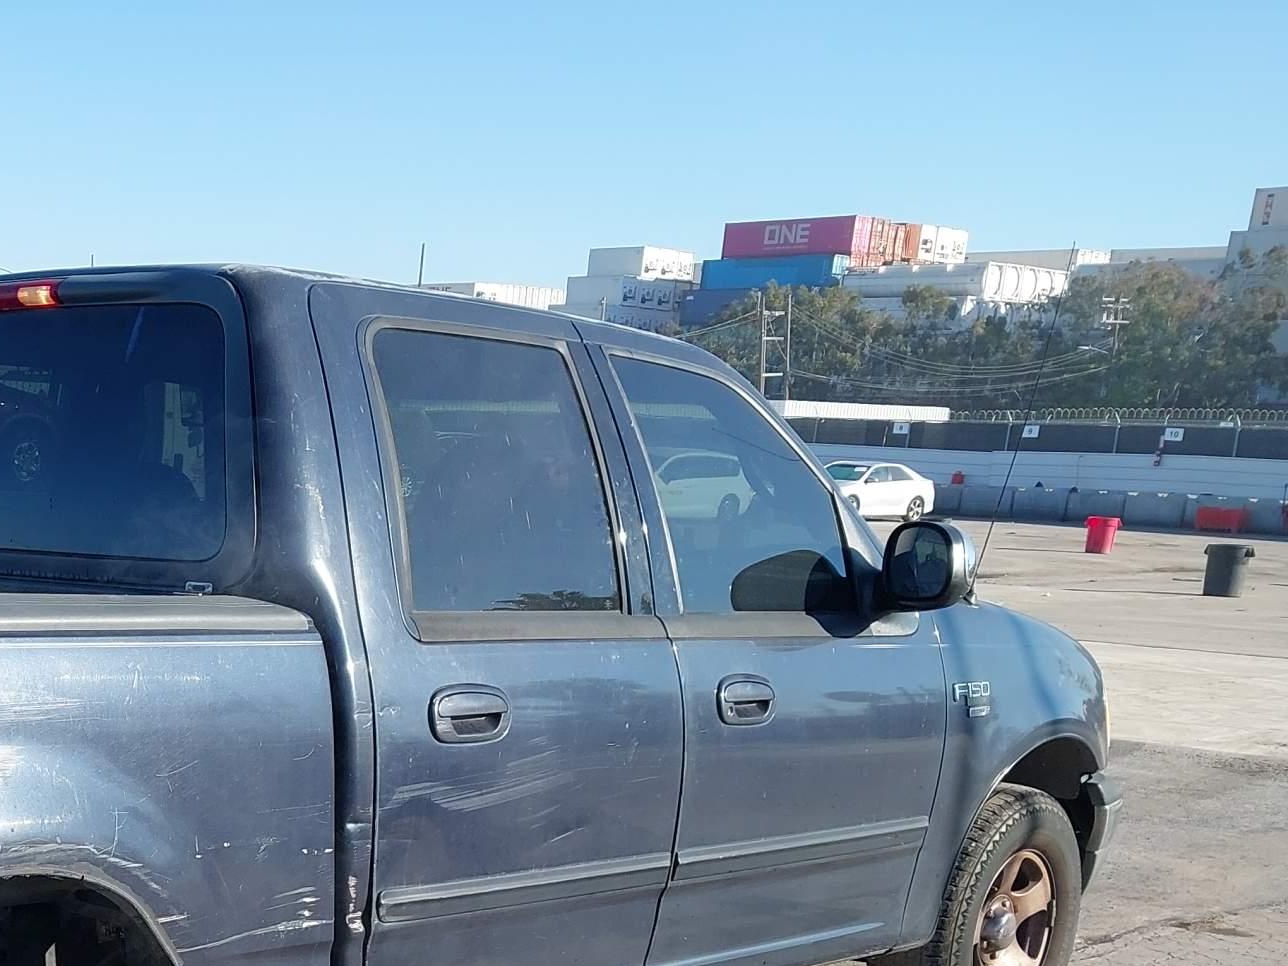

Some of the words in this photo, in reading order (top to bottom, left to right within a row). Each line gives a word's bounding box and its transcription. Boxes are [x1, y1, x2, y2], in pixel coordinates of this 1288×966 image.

[763, 223, 810, 245] ONE
[1169, 430, 1180, 439] 10
[953, 681, 990, 702] F150
